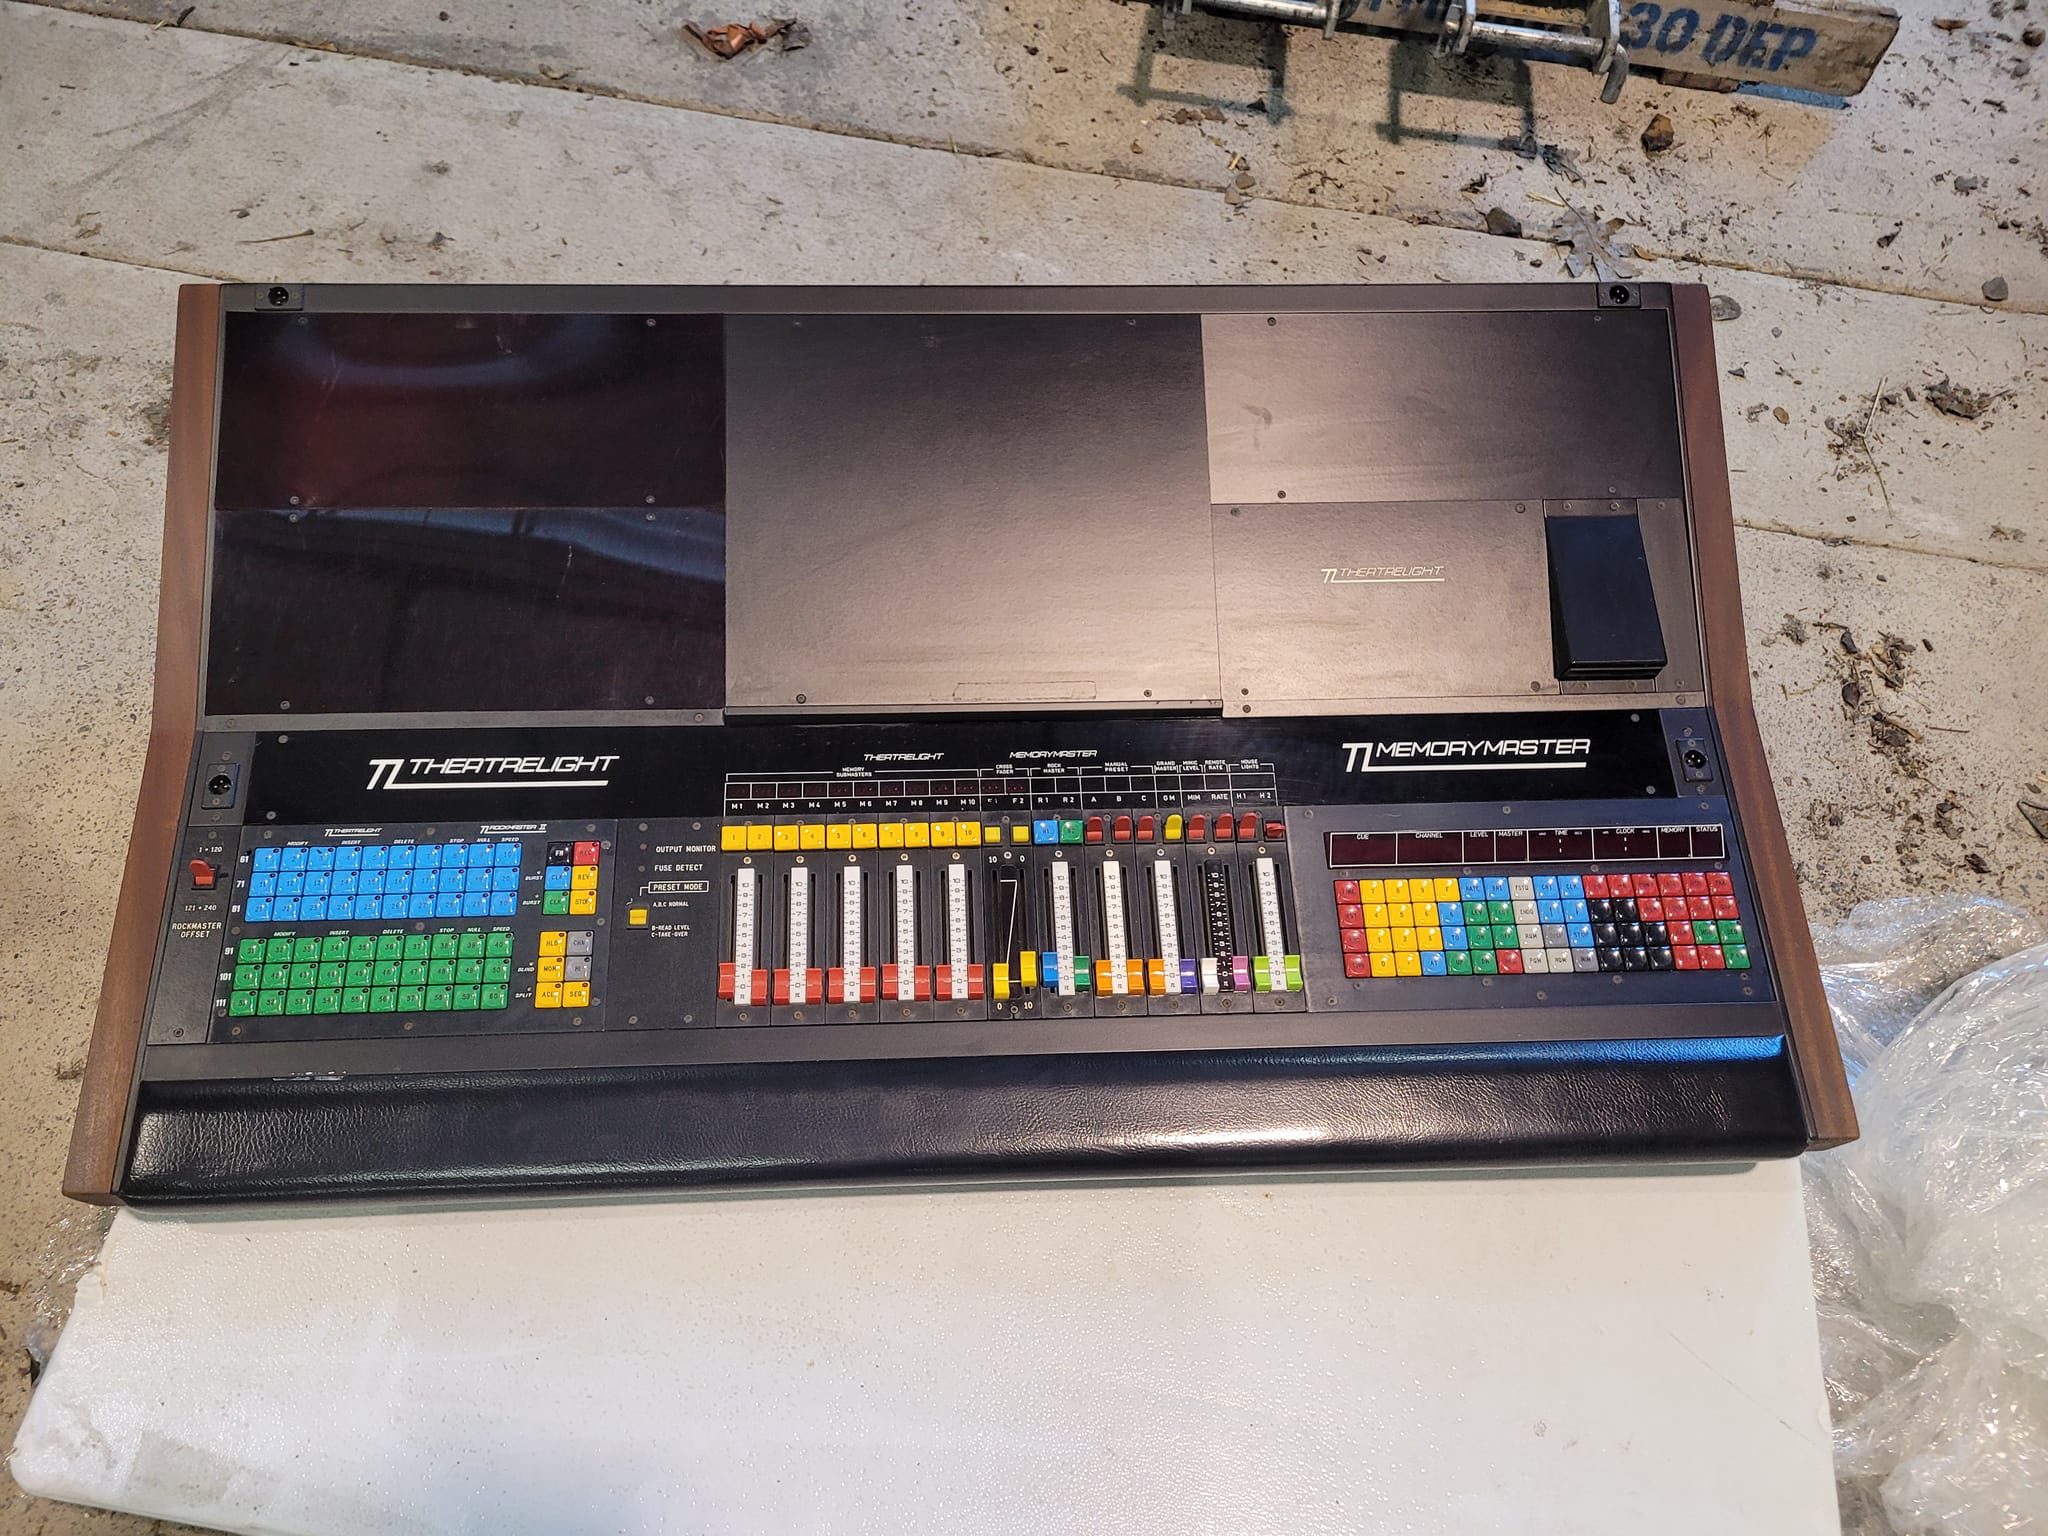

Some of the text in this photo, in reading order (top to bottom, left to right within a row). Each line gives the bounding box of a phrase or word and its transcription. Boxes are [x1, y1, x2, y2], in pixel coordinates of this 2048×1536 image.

[1702, 14, 1818, 72] DEP
[1376, 739, 1591, 757] MEMORYMASTER
[1009, 750, 1097, 758] MEMORYMASTER
[409, 755, 620, 774] THEATRELIGHT
[236, 880, 245, 888] 71
[172, 922, 222, 930] ROCKMASTER
[224, 947, 234, 955] 91
[219, 973, 232, 981] 101
[216, 999, 226, 1007] 111
[997, 1002, 1002, 1010] 0
